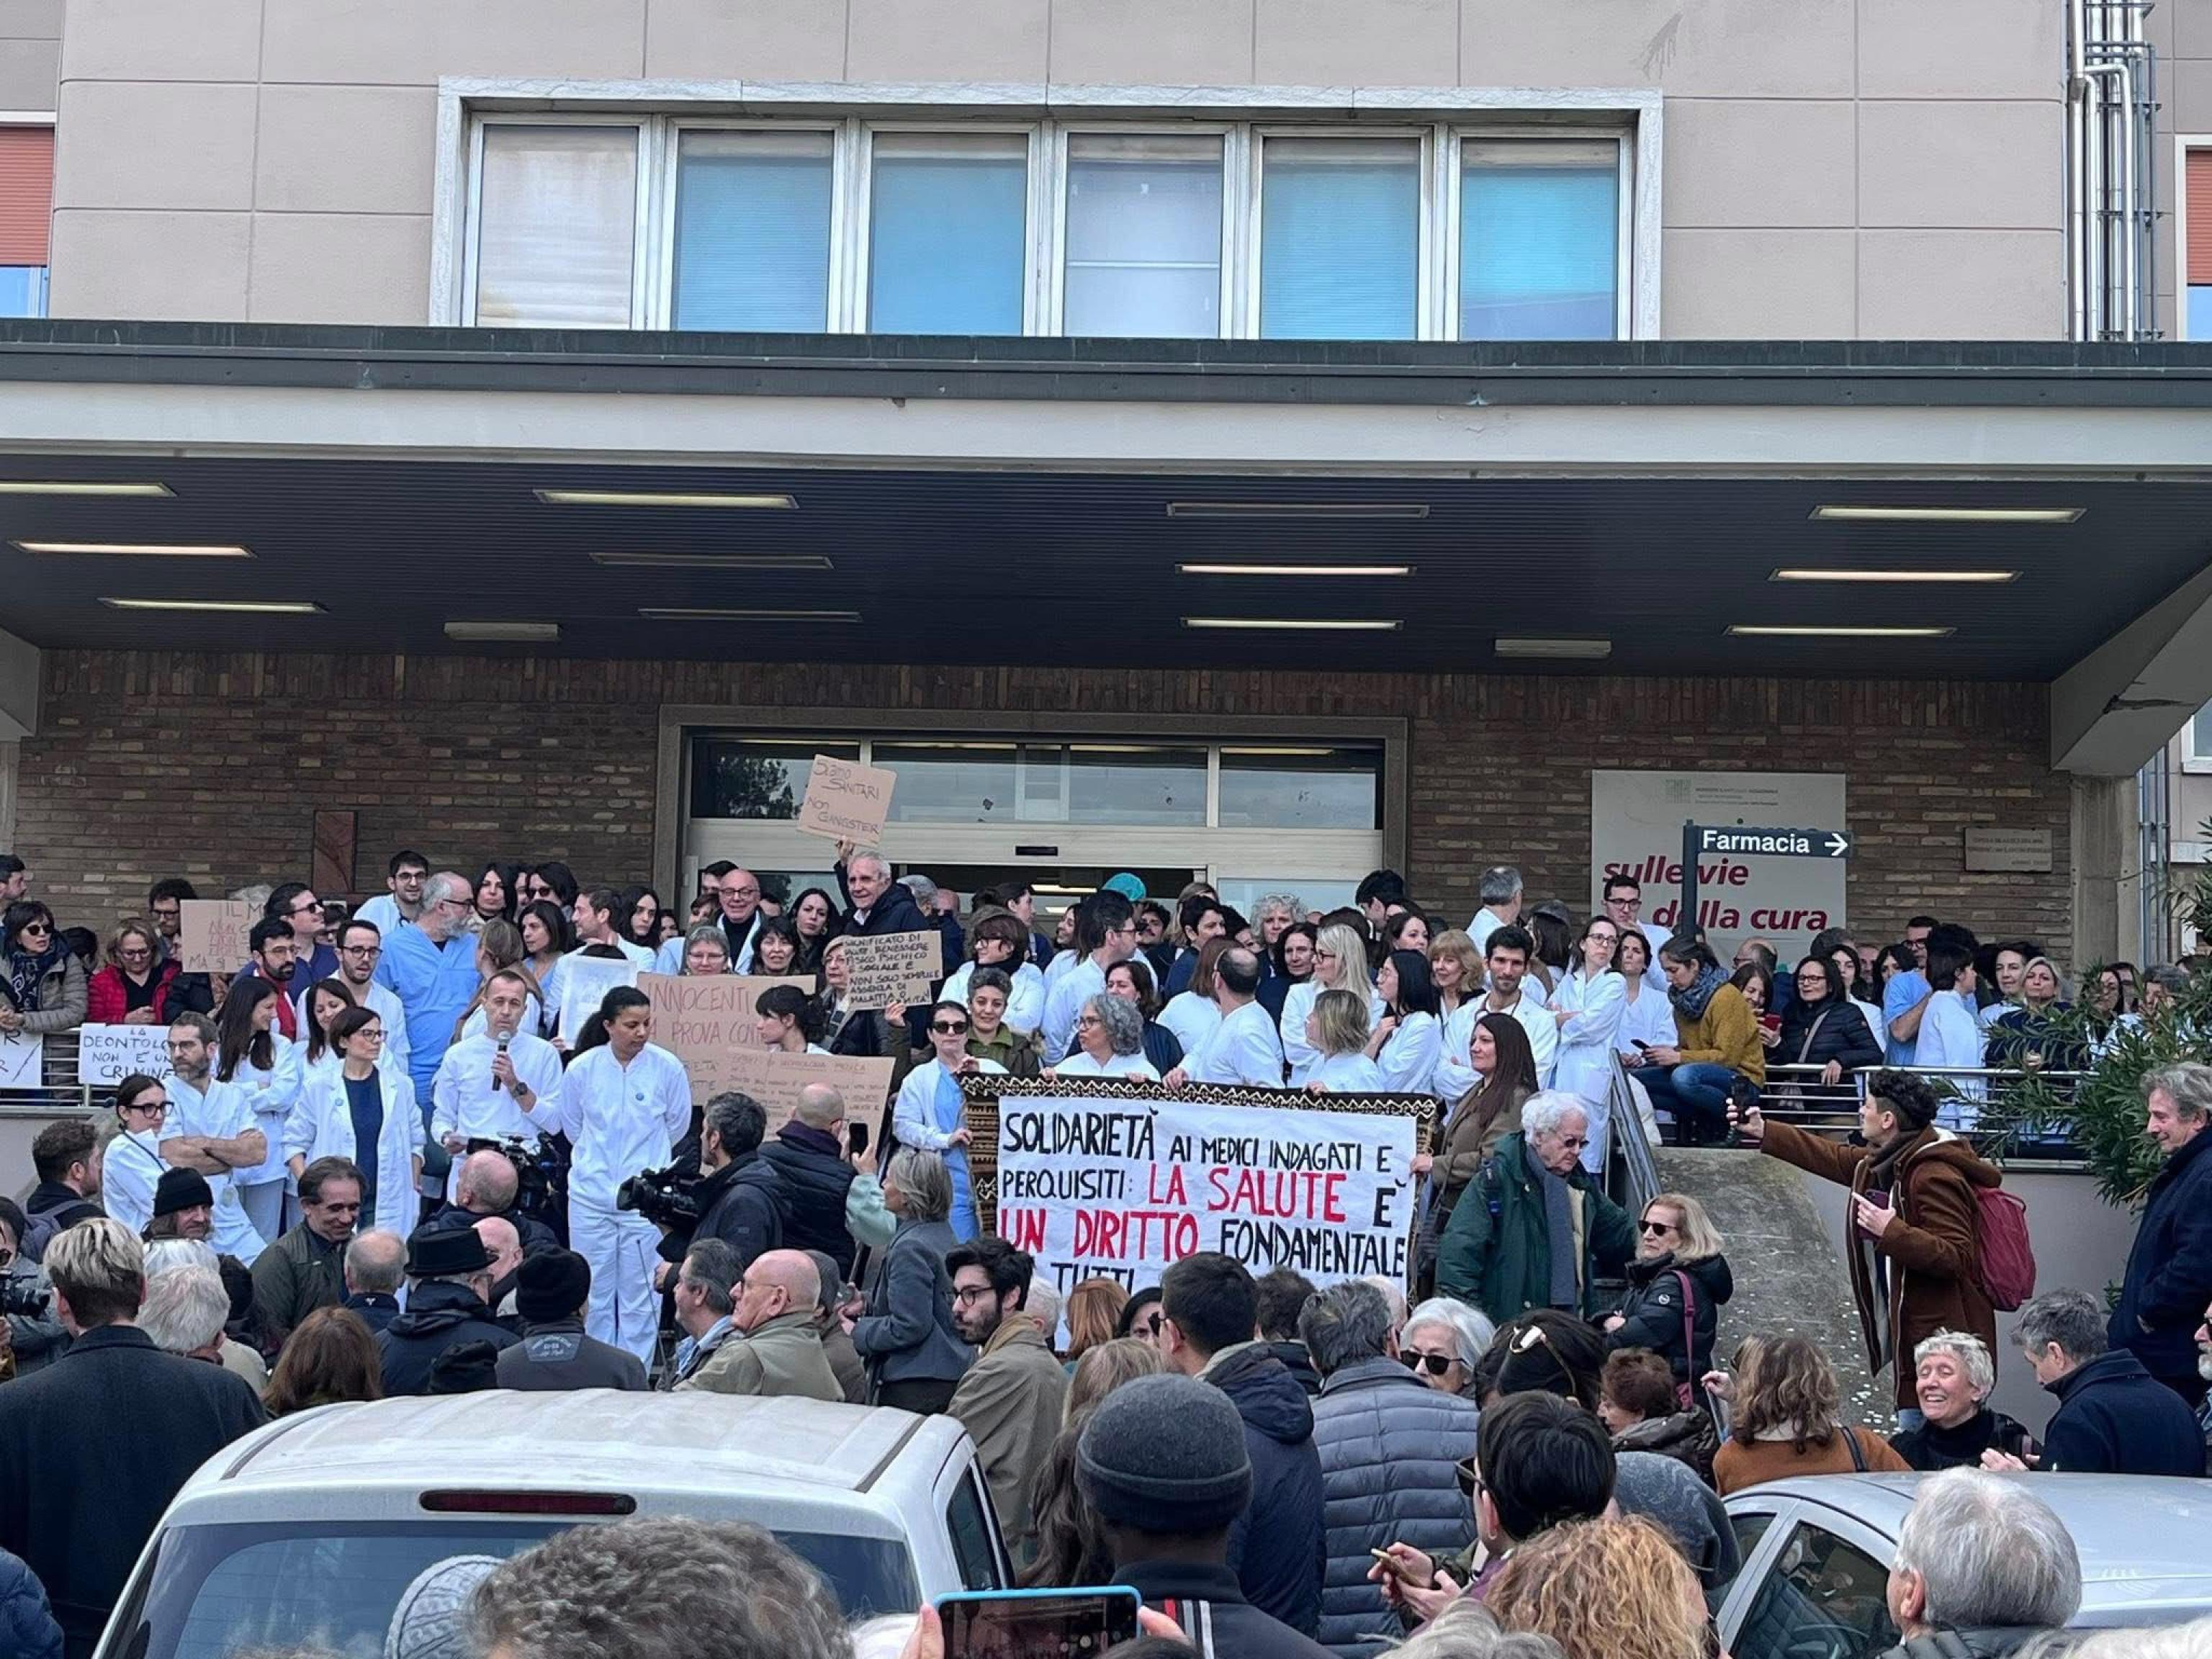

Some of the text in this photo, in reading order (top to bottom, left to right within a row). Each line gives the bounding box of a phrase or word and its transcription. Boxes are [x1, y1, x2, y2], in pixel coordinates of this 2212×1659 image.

[817, 811, 880, 835] GANGSTER
[1702, 830, 1810, 854] Farmacia
[1697, 858, 1749, 886] vie
[1652, 899, 1828, 931] dlla cura
[909, 932, 921, 943] DI
[649, 979, 750, 1015] INNOCENTI
[671, 1021, 721, 1045] PROVA
[92, 1052, 120, 1062] NON
[100, 1064, 177, 1079] CRIMINE
[1002, 1105, 1393, 1173] SOLIDARIETÀ AI MEDICI INDAGATI E
[1001, 1168, 1133, 1200] PERQUISITI:
[1148, 1163, 1187, 1206] LA
[1207, 1167, 1347, 1223] SALUTE
[1000, 1208, 1406, 1277] UN DIRITTO FONDAMENTALE
